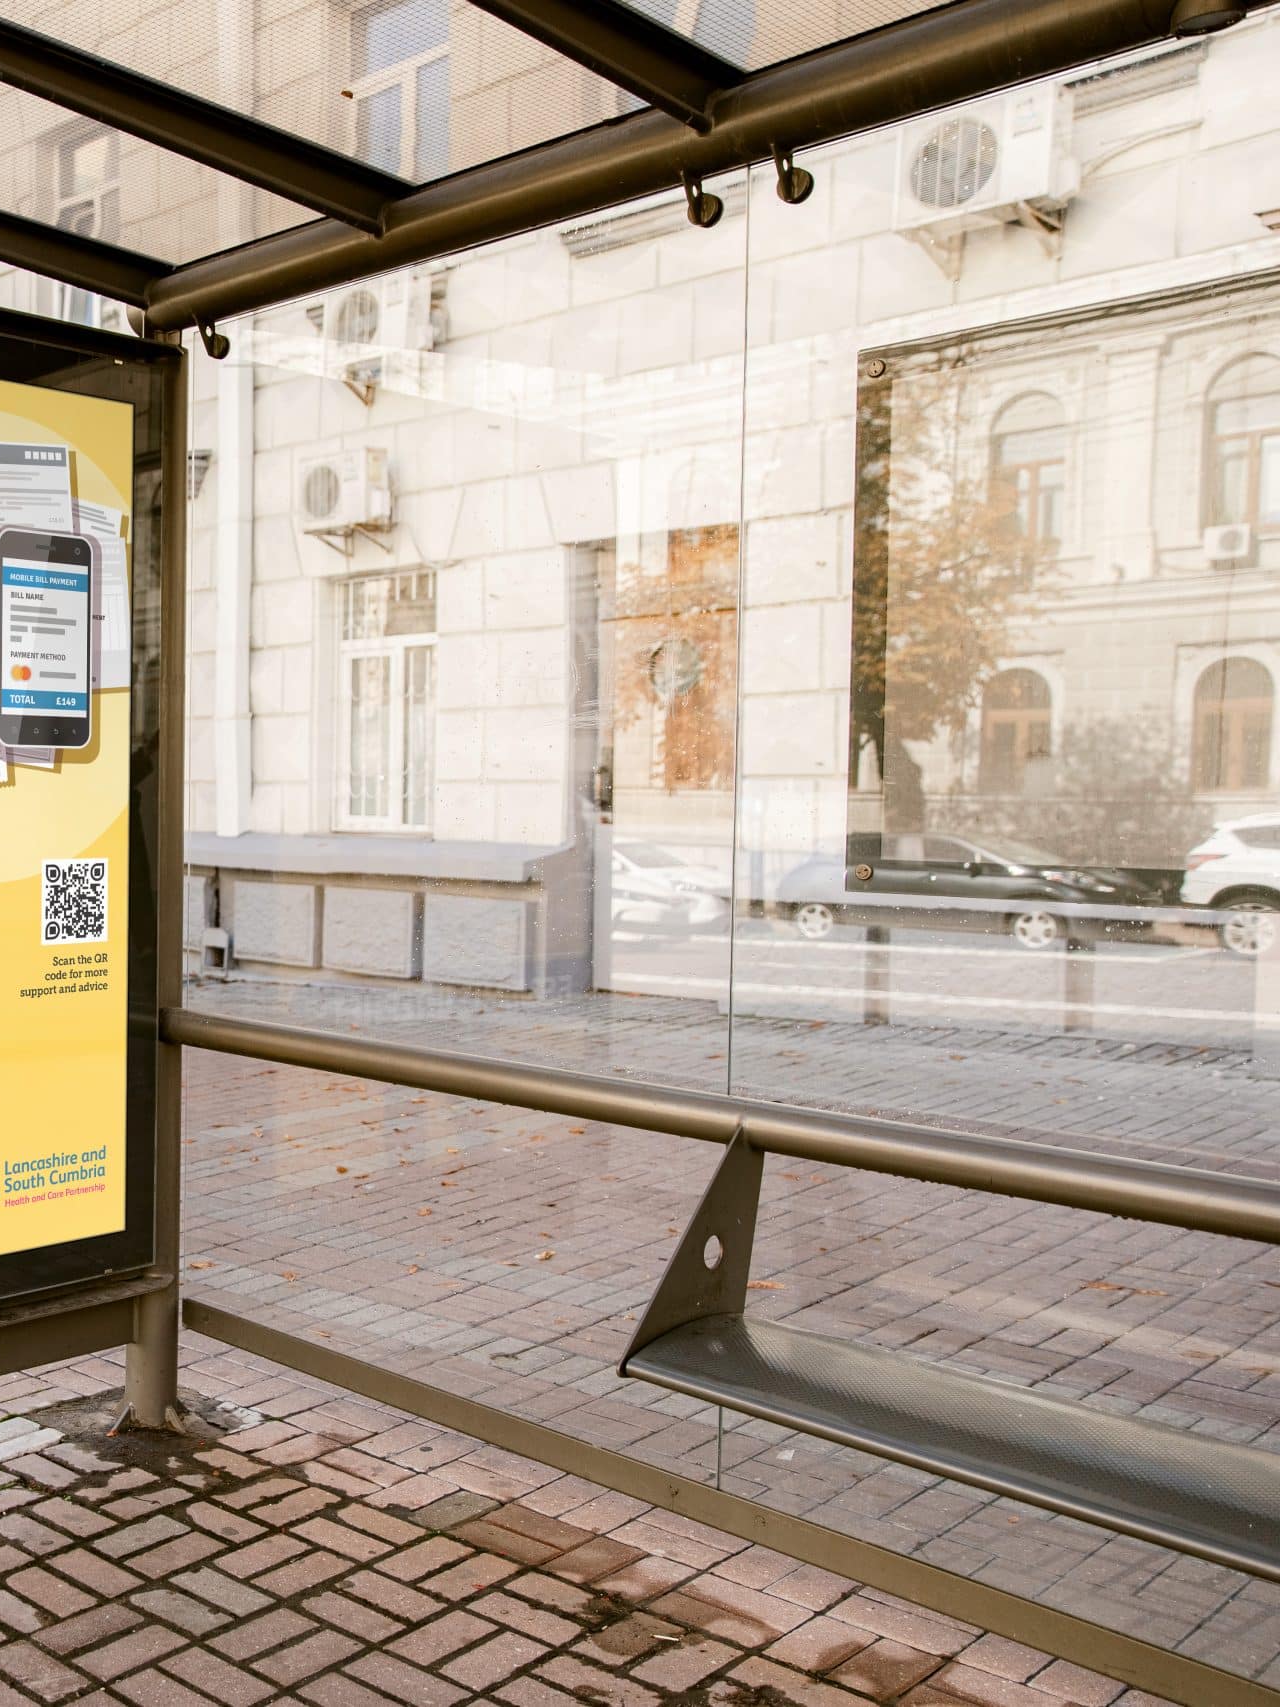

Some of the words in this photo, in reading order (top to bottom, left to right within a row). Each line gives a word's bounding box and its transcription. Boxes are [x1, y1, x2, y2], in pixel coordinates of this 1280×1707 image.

[10, 573, 34, 583] MOBILE
[35, 576, 49, 585] BILL
[49, 578, 78, 587] PAYMENT
[11, 591, 25, 599] BILL
[25, 593, 44, 601] NAME
[10, 651, 39, 660] PAYMENT
[40, 652, 66, 661] METHOD
[10, 694, 36, 705] TOTAL
[56, 697, 76, 706] £149
[53, 957, 75, 966] Scan
[78, 955, 92, 964] the
[94, 953, 108, 962] QR
[45, 971, 67, 980] code
[70, 969, 83, 978] for
[85, 969, 108, 977] more
[20, 986, 57, 998] support
[59, 983, 76, 993] and
[79, 982, 108, 992] advice
[4, 1153, 78, 1175] Lancashire
[81, 1145, 106, 1162] and
[4, 1173, 45, 1192] South
[50, 1165, 105, 1184] Cumbria
[5, 1196, 30, 1207] Health
[32, 1194, 46, 1202] and
[48, 1191, 64, 1199] Care
[66, 1183, 105, 1196] Partnership
